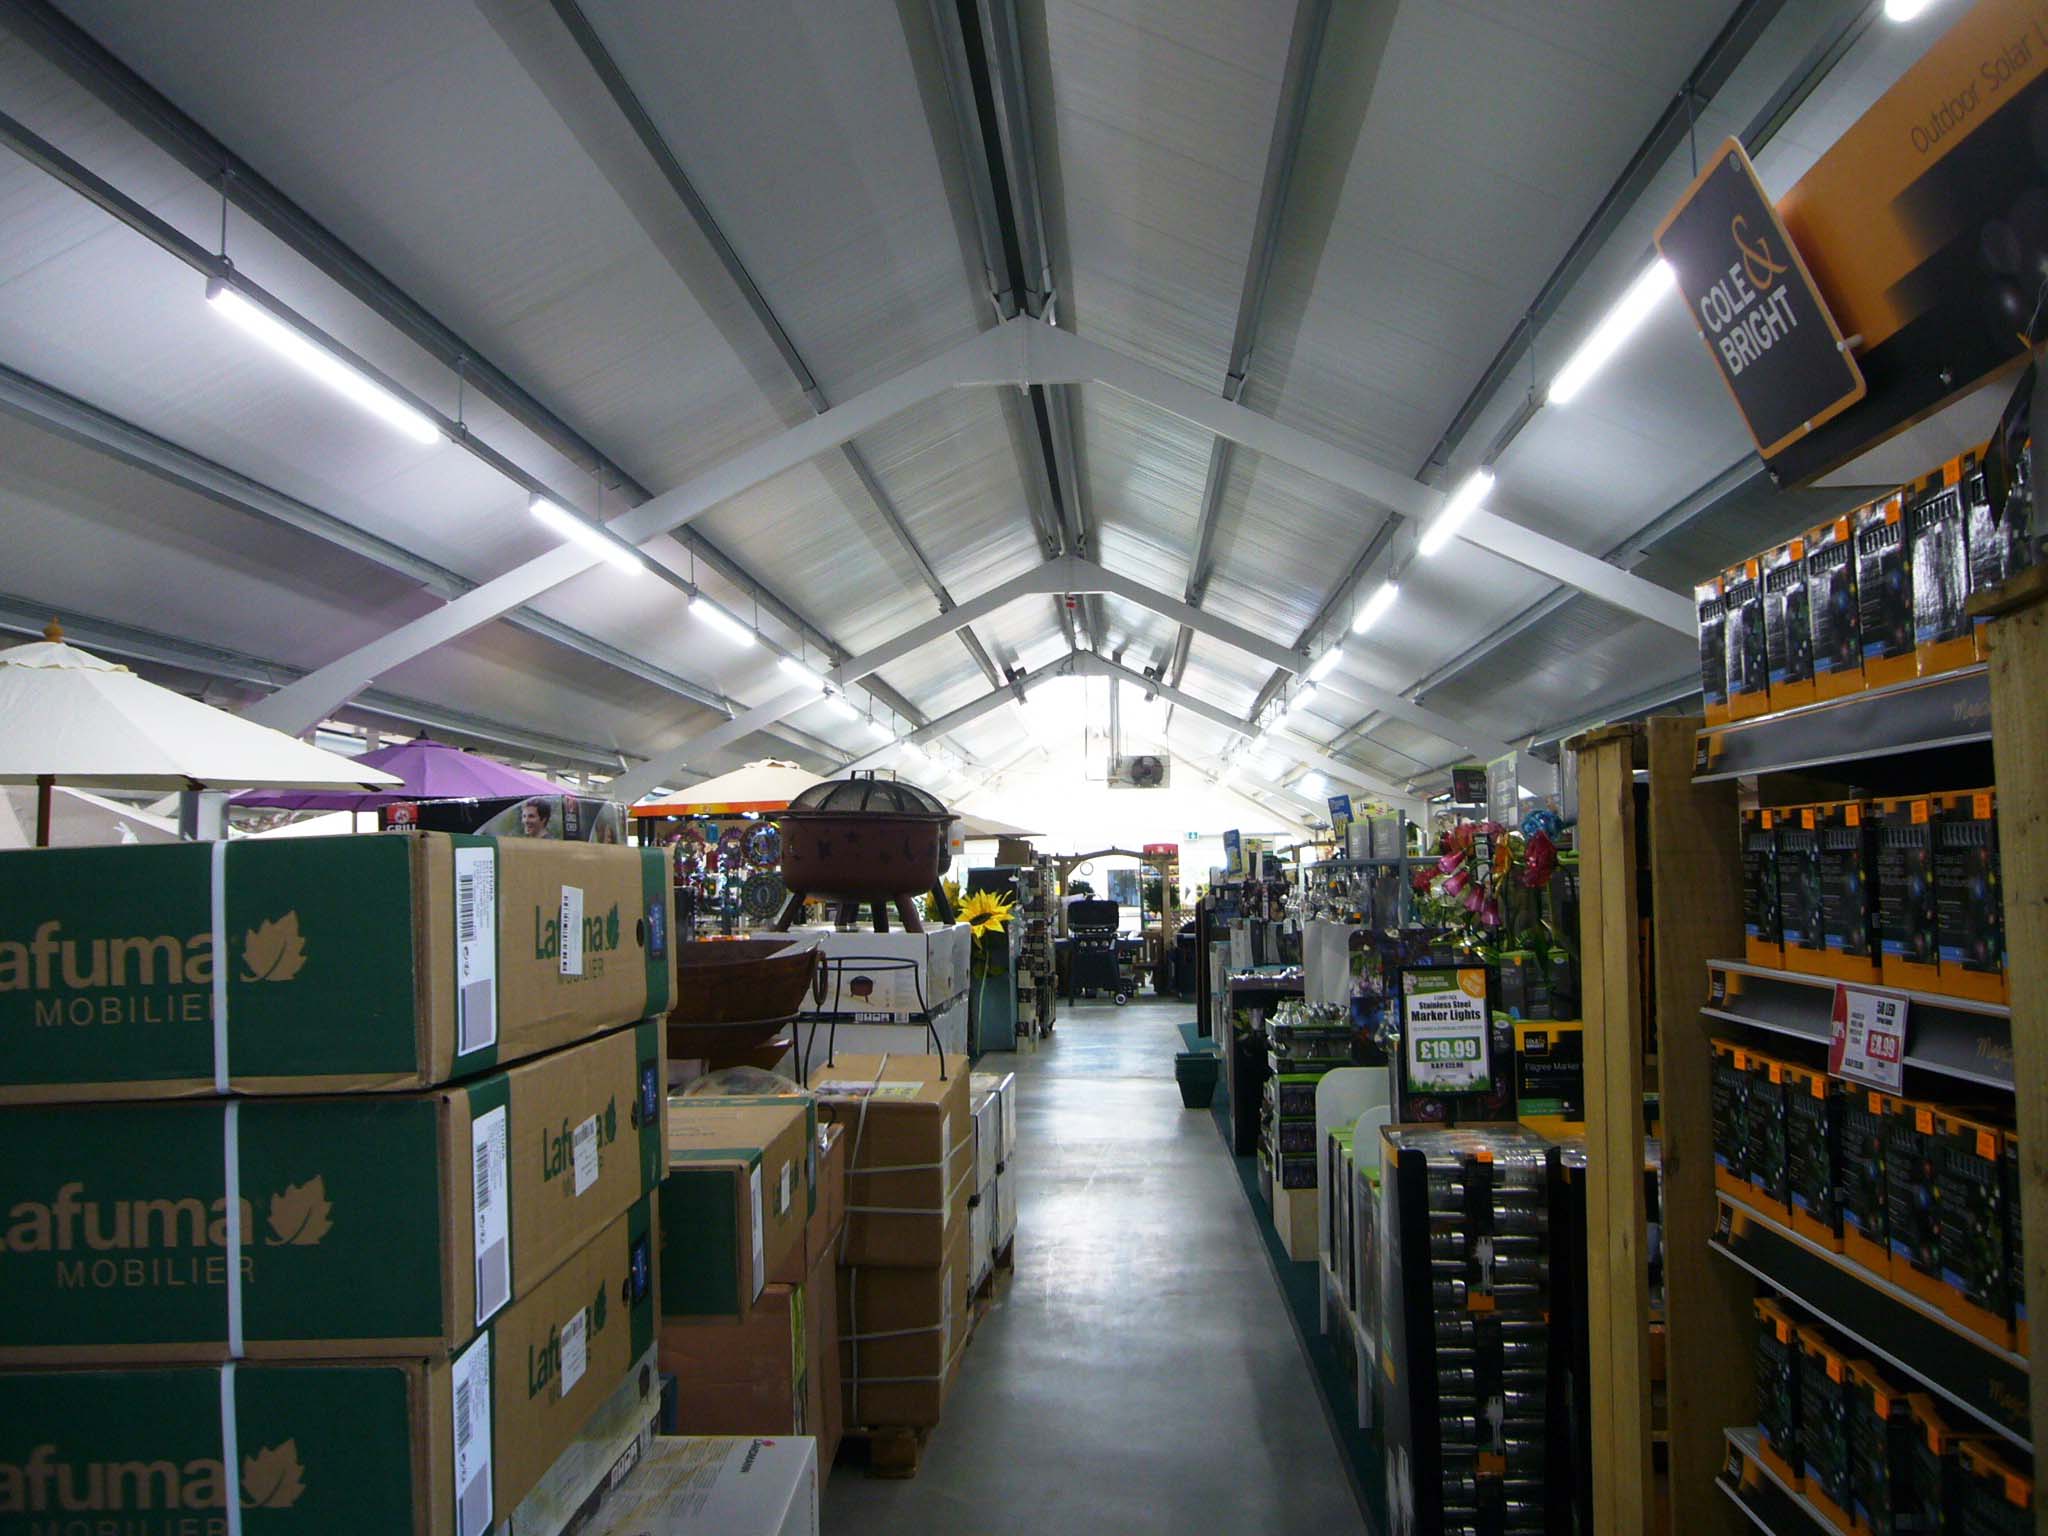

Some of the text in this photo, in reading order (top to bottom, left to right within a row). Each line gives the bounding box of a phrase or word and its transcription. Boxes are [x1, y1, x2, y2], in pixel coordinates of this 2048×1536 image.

[1911, 79, 1978, 153] Outdoor
[1980, 35, 2032, 93] Solar
[1701, 215, 1788, 333] COLE &
[1719, 285, 1797, 376] BRIGHT
[1411, 1009, 1481, 1022] Marker Lights
[1419, 1000, 1471, 1010] Stainless Steel
[1420, 1040, 1476, 1060] £19.99
[0, 1181, 254, 1252] afuma
[55, 1255, 256, 1289] MOBILIER
